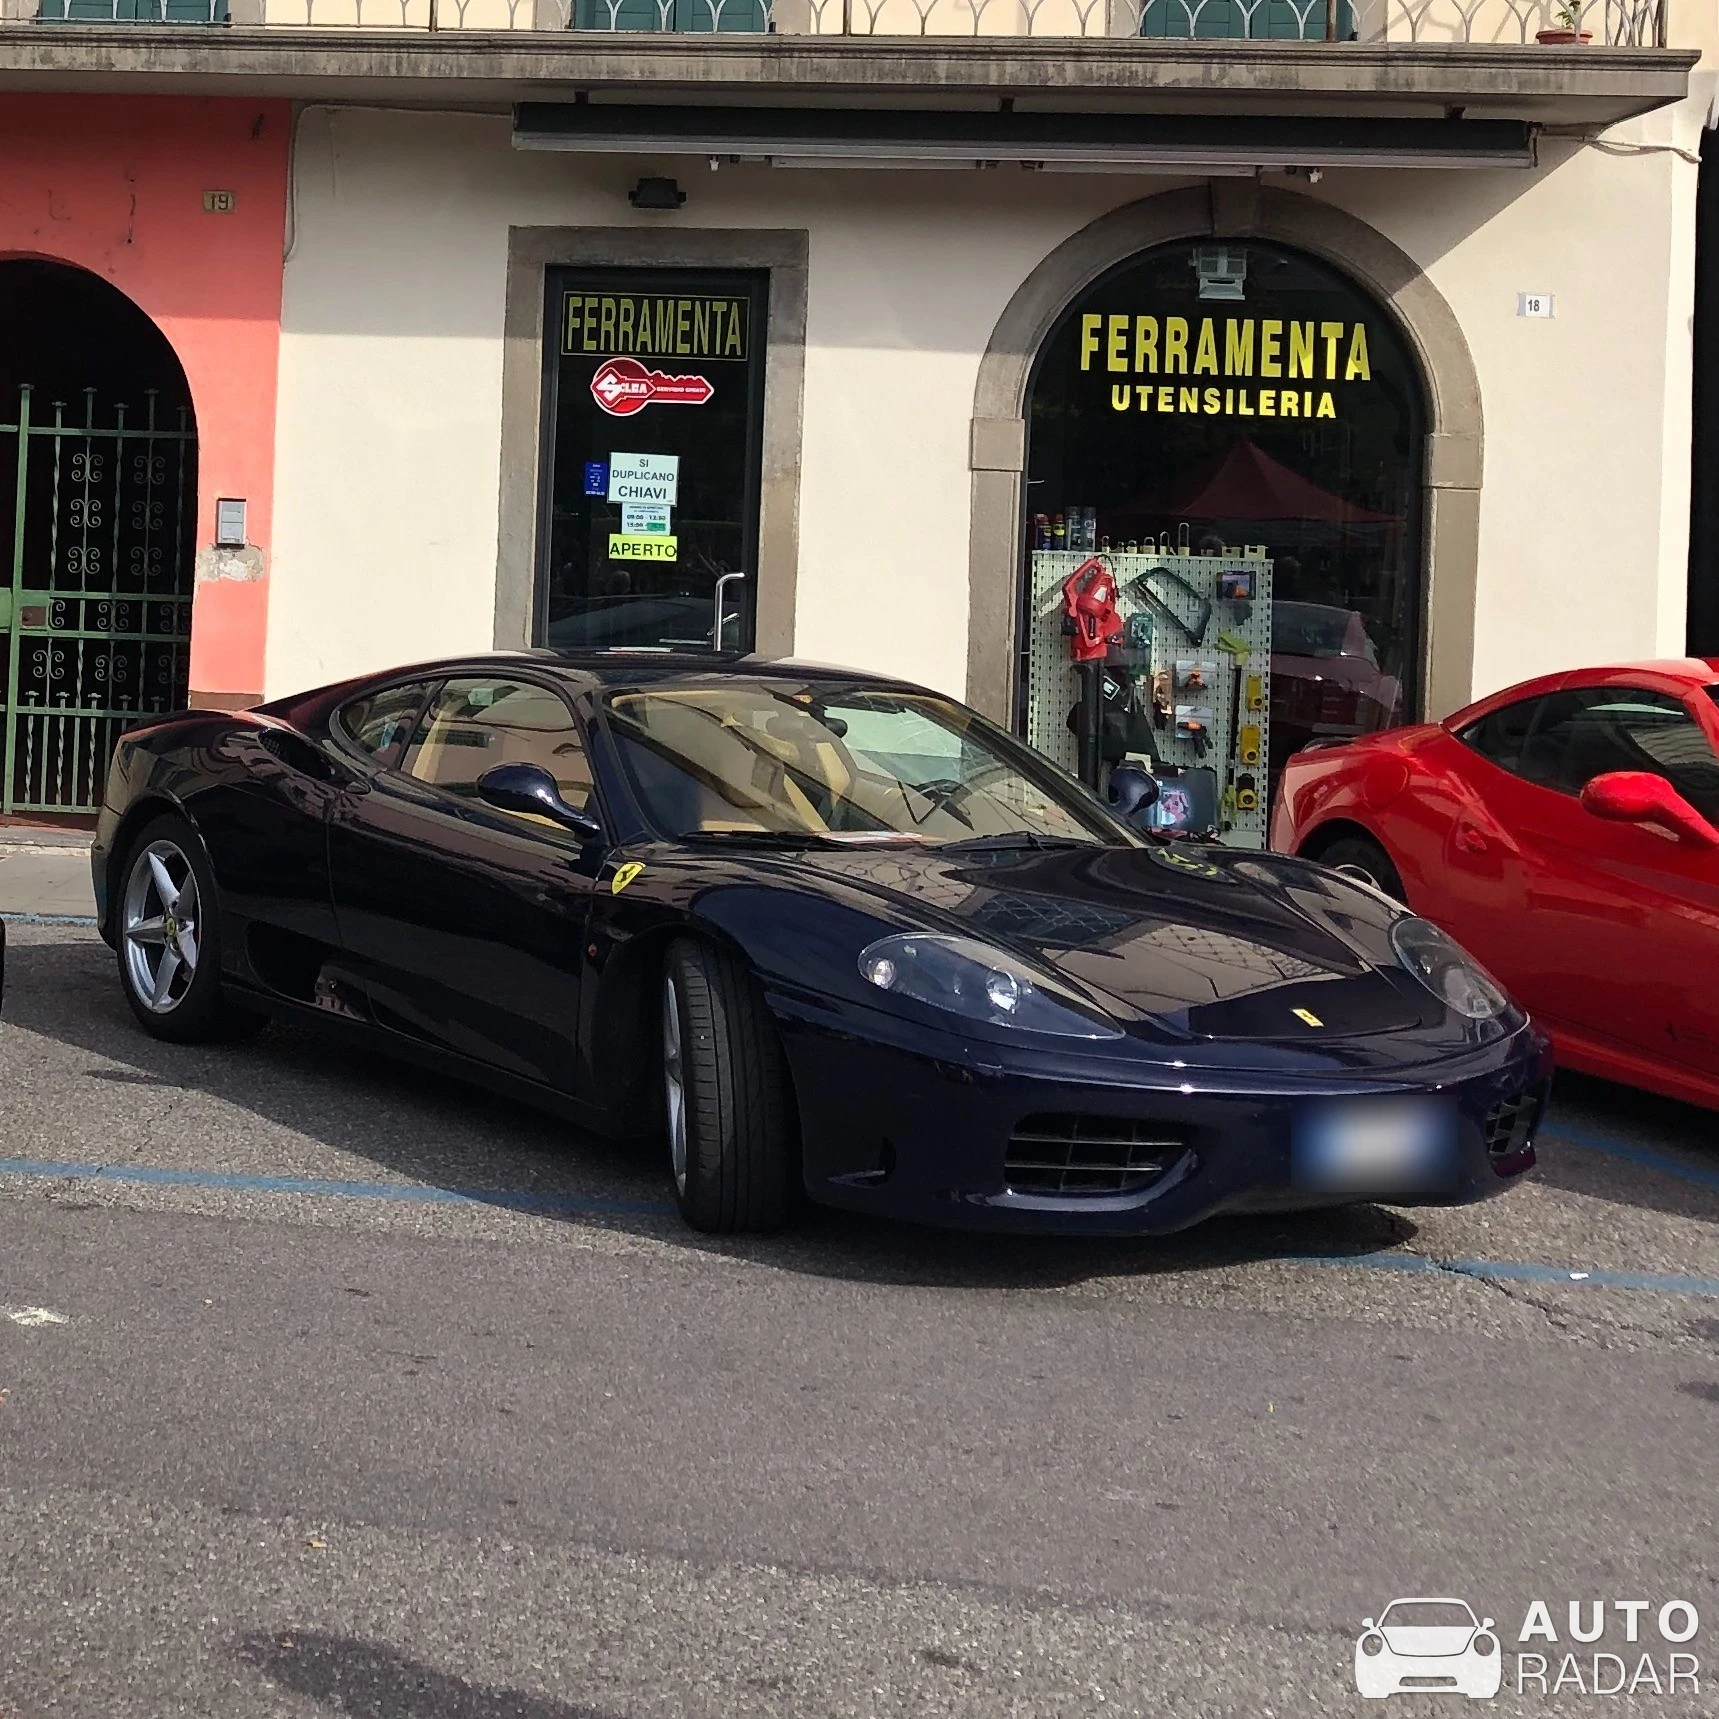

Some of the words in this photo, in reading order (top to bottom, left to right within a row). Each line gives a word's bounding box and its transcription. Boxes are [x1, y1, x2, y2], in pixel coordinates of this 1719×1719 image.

[211, 194, 229, 210] 19
[1528, 299, 1540, 312] 18
[567, 296, 742, 356] FERRAMENTA
[1080, 313, 1371, 381] FERRAMENTA
[1111, 384, 1337, 419] UTENSILERIA
[639, 458, 649, 468] SI
[612, 469, 675, 482] DUPLICANO
[618, 485, 667, 500] CHIAVI
[609, 542, 677, 558] APERTO
